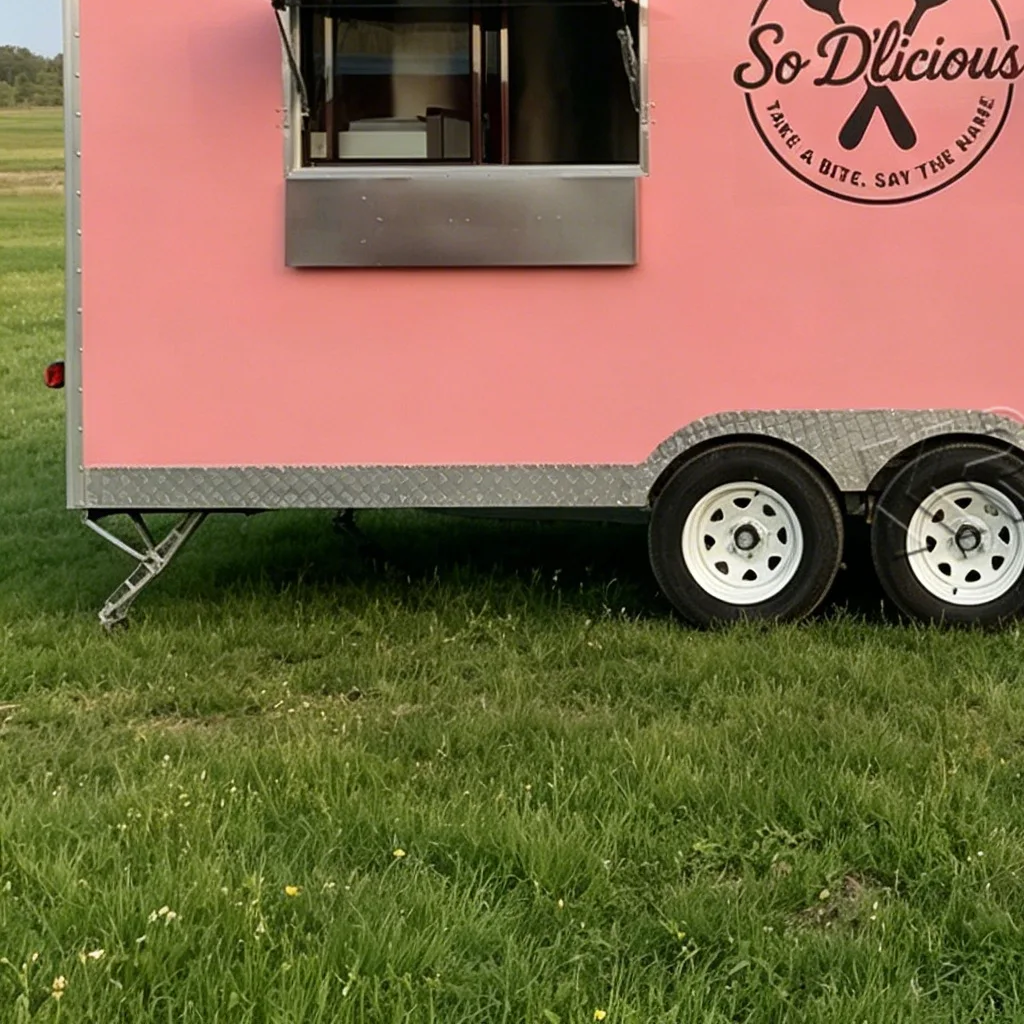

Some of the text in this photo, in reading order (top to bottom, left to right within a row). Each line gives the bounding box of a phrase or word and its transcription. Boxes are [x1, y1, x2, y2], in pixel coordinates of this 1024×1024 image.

[733, 23, 811, 90] So
[766, 99, 801, 150] TAKE
[799, 148, 814, 166] A
[874, 169, 911, 189] SAY
[914, 148, 956, 180] THE
[954, 94, 996, 152] NAME
